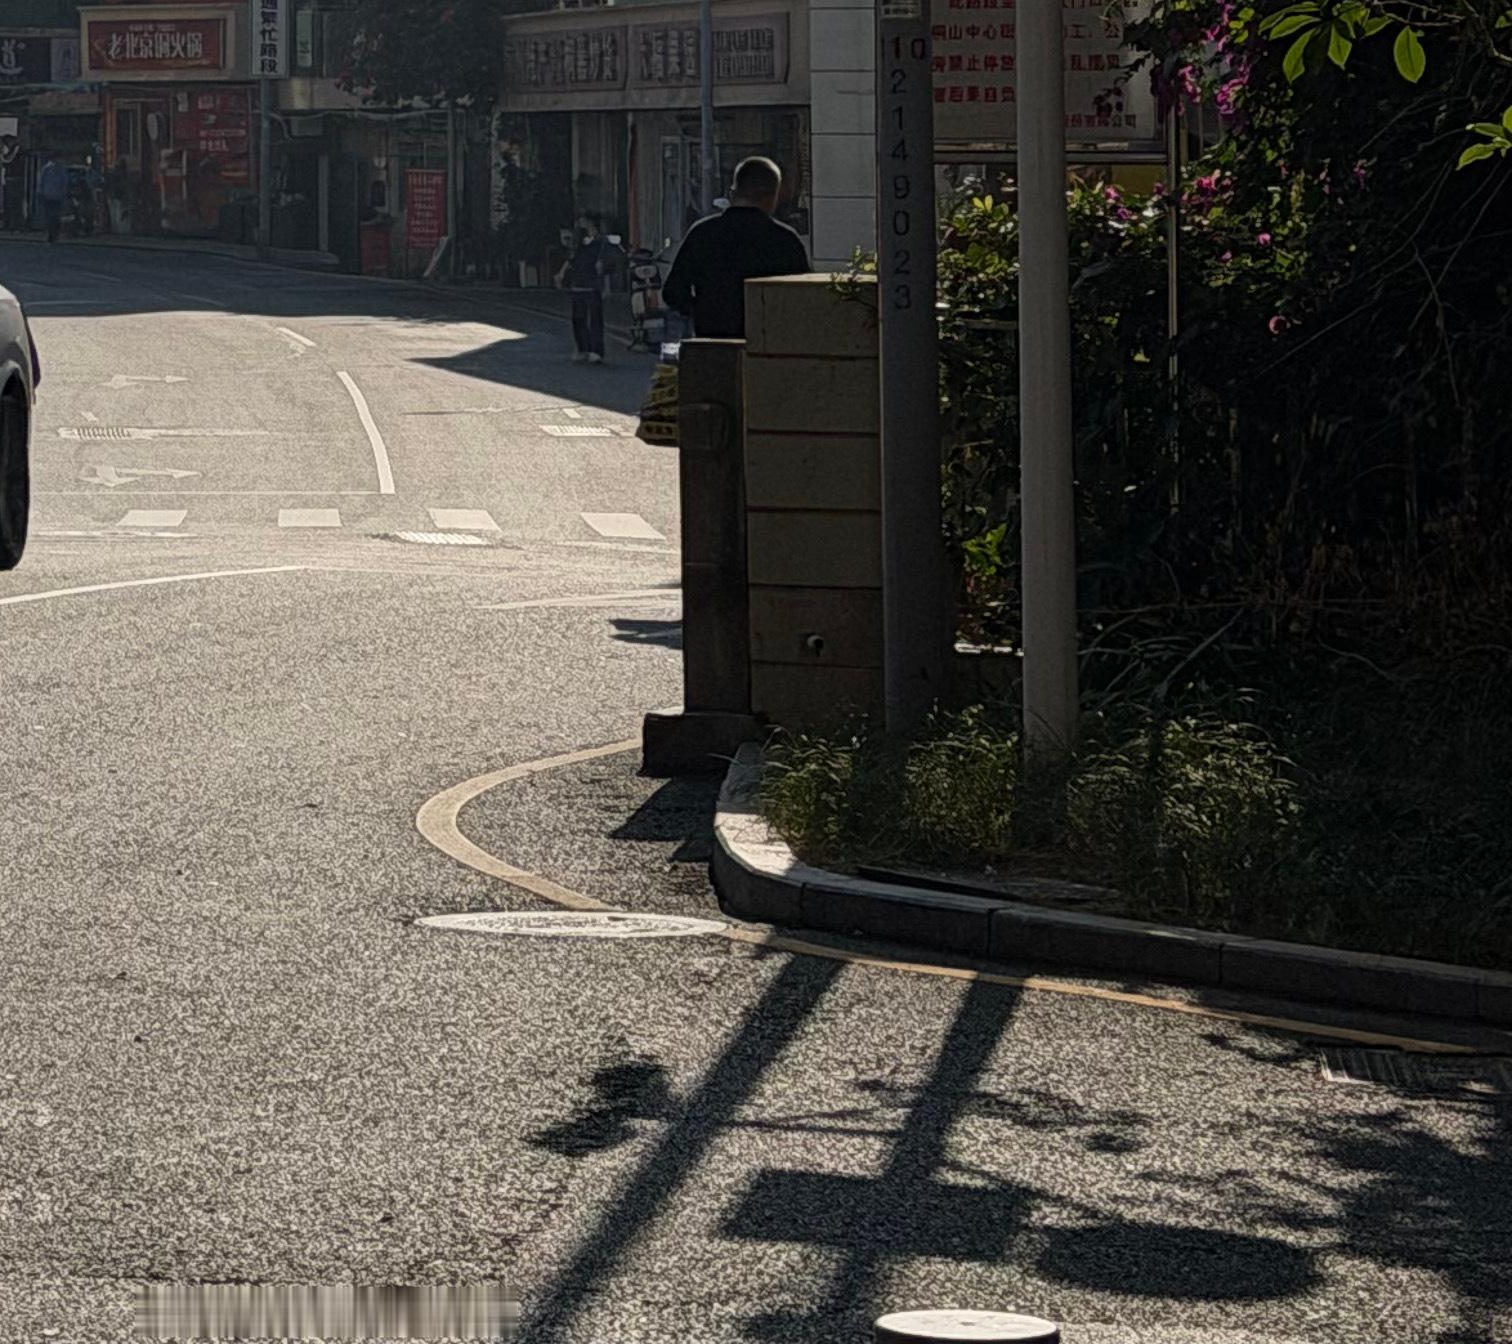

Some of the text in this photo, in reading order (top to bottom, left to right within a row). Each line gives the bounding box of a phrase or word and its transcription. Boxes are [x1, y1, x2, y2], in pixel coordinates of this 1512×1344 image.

[108, 32, 202, 59] 老北京铜火锅
